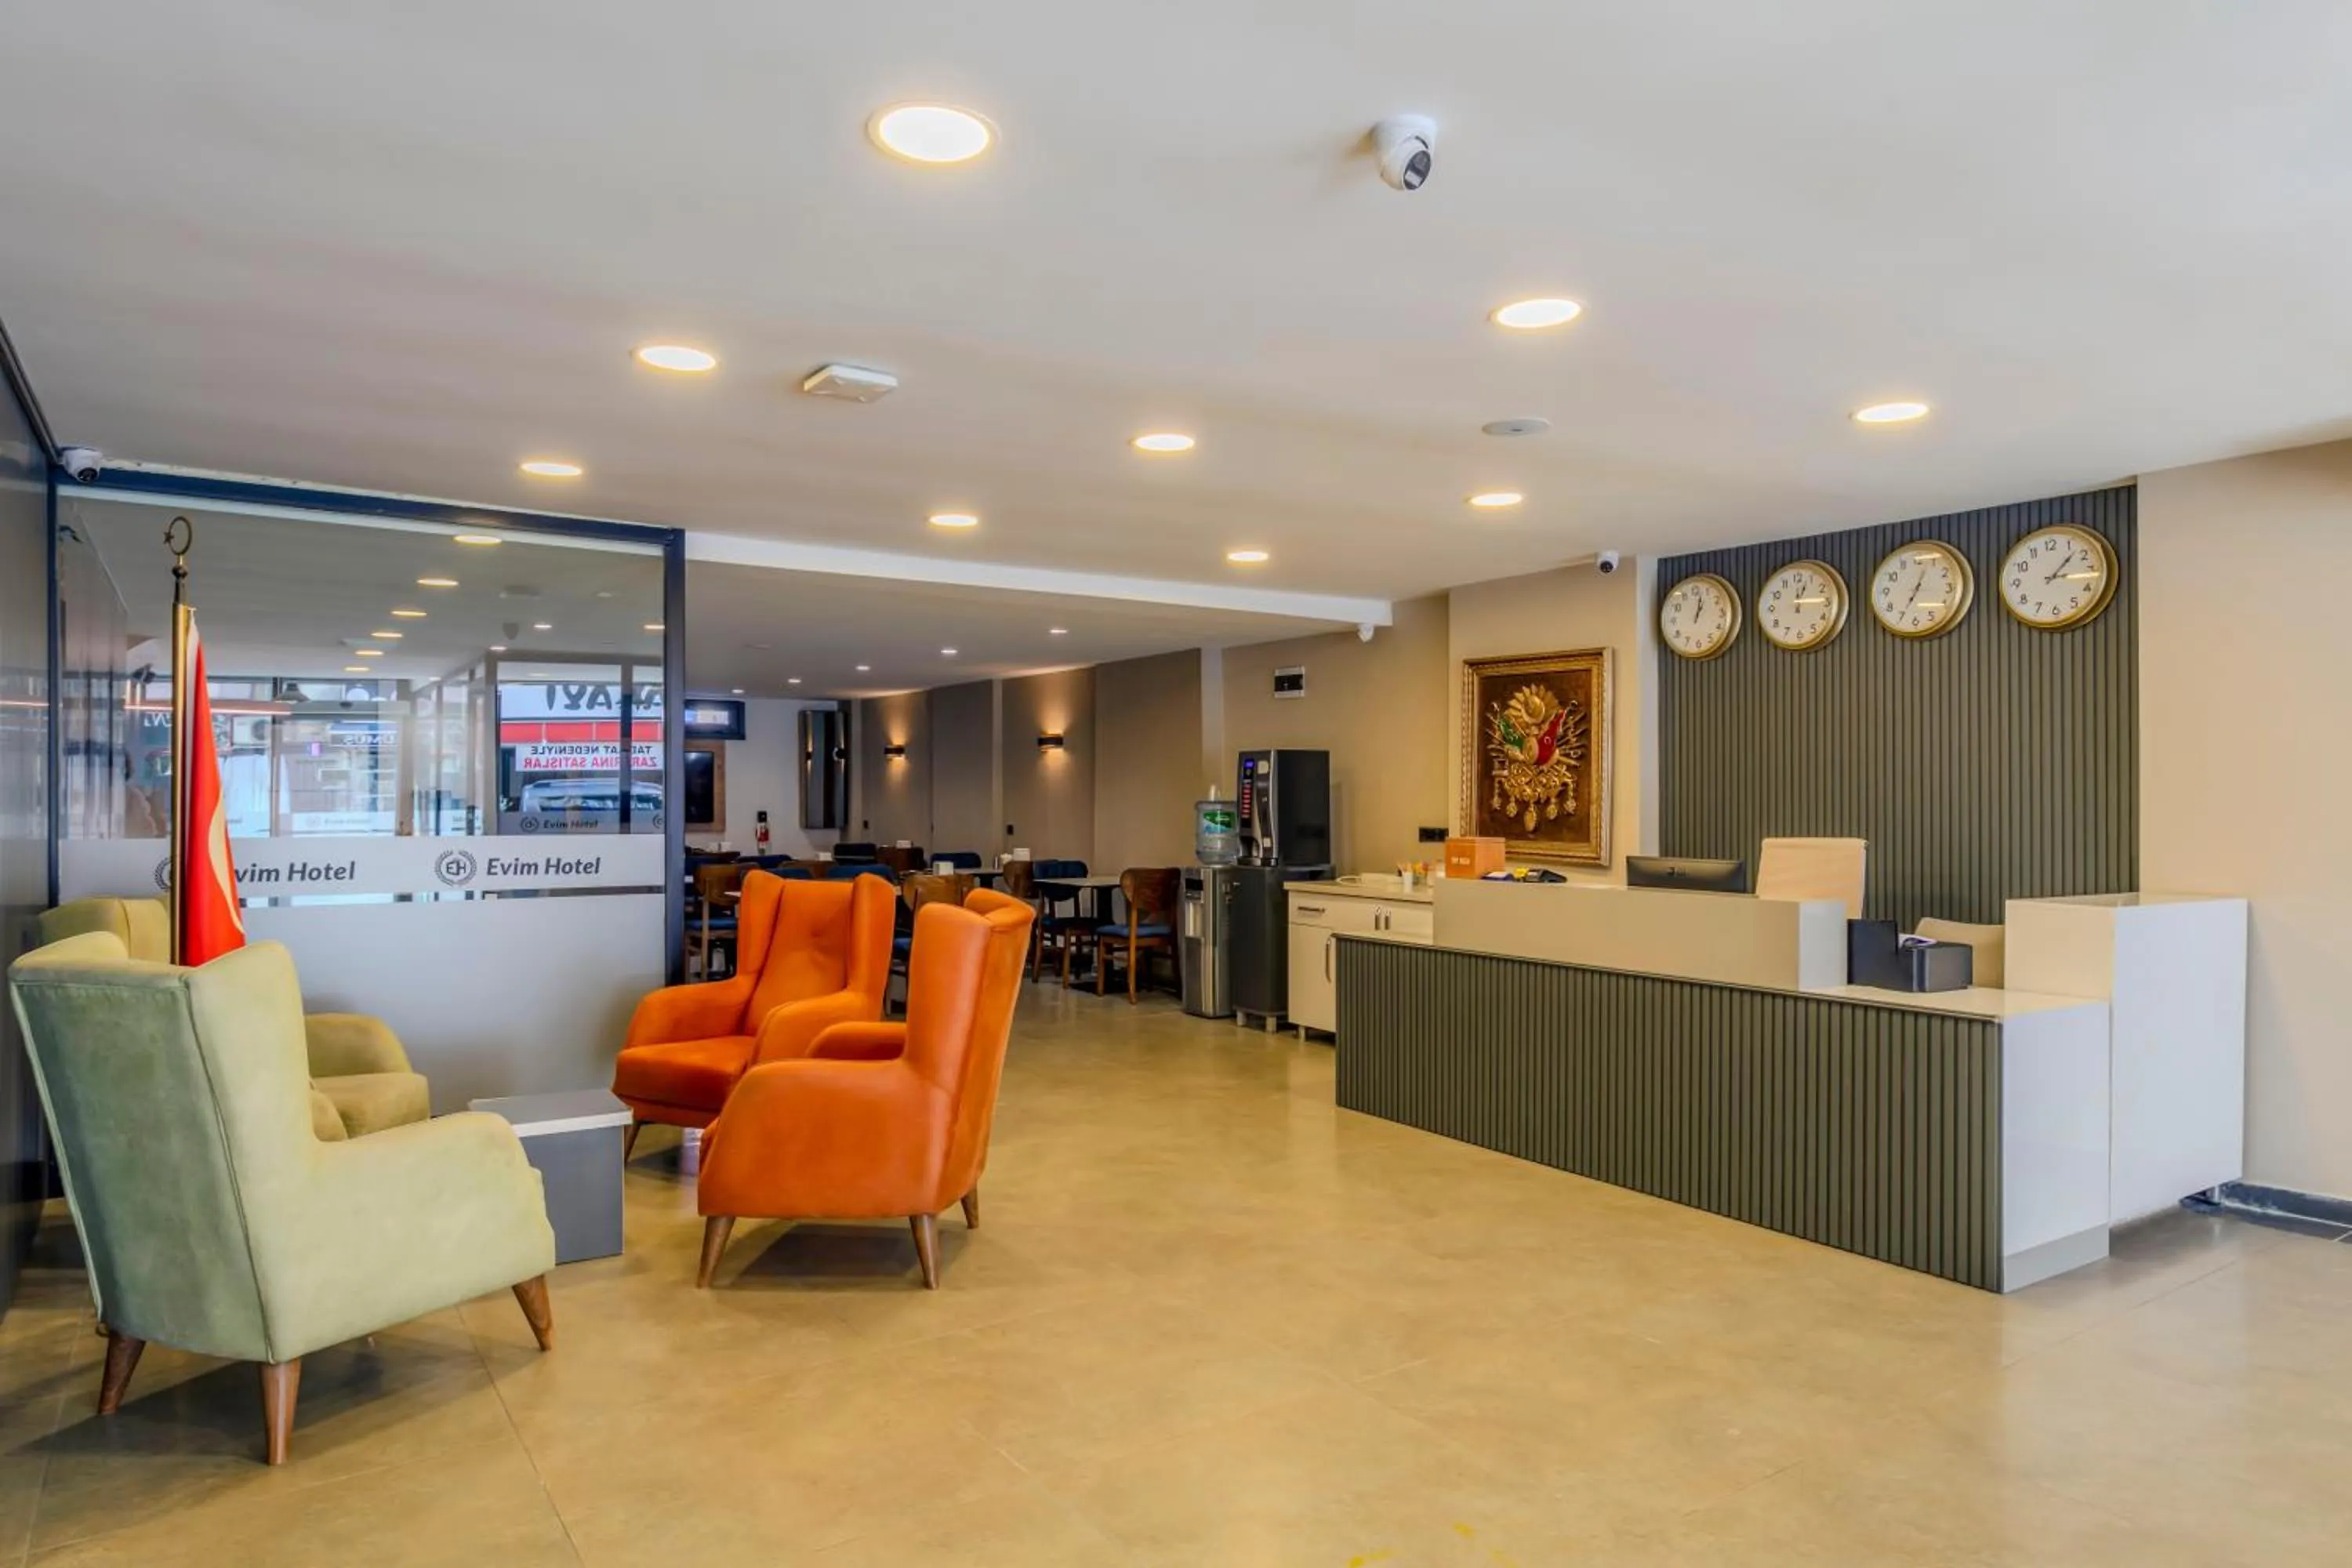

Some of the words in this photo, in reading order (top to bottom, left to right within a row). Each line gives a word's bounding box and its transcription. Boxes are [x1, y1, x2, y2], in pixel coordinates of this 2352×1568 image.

[2045, 539, 2057, 551] 12
[2067, 539, 2071, 550] 1
[2029, 547, 2038, 559] 11
[2080, 550, 2089, 561] 2
[1941, 567, 1949, 578] 2
[2016, 561, 2028, 573] 10
[1793, 573, 1802, 583] 12
[1888, 572, 1898, 582] 10
[1819, 583, 1826, 593] 2
[1945, 583, 1953, 594] 3
[2011, 578, 2021, 588] 9
[2082, 583, 2092, 592] 4
[1882, 587, 1890, 597] 9
[2020, 593, 2028, 604] 8
[2070, 597, 2078, 609] 5
[2035, 601, 2043, 613] 7
[2052, 605, 2060, 615] 6
[1898, 611, 1906, 624] 7
[1911, 616, 1920, 626] 6
[1927, 611, 1935, 622] 5
[1784, 626, 1791, 638] 7
[1810, 623, 1817, 633] 5
[1796, 630, 1803, 640] 6
[234, 862, 281, 883] vim
[288, 861, 356, 882] Hotel
[486, 857, 539, 877] Evim
[543, 856, 602, 876] Hotel
